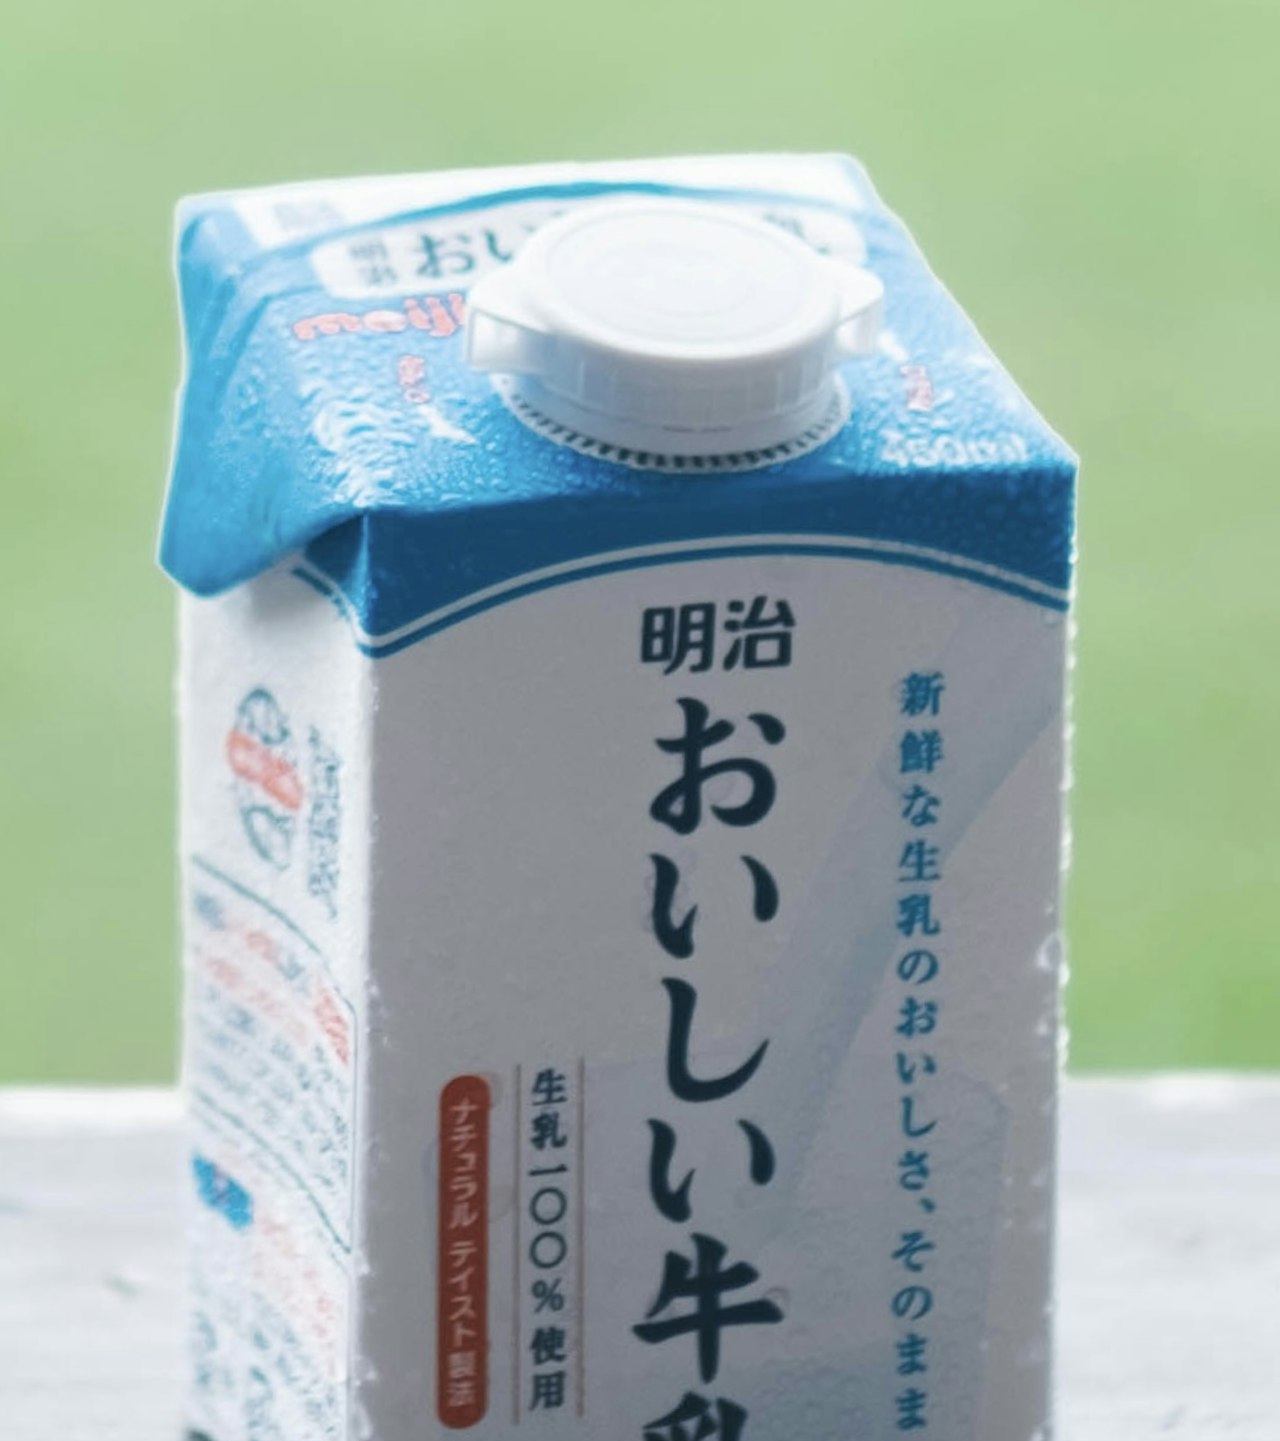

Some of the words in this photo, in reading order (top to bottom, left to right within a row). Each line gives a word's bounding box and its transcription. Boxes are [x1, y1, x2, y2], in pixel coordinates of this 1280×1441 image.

[640, 595, 797, 676] 明治
[890, 670, 946, 1433] 新鮮な生乳のおいしさ、そのまま
